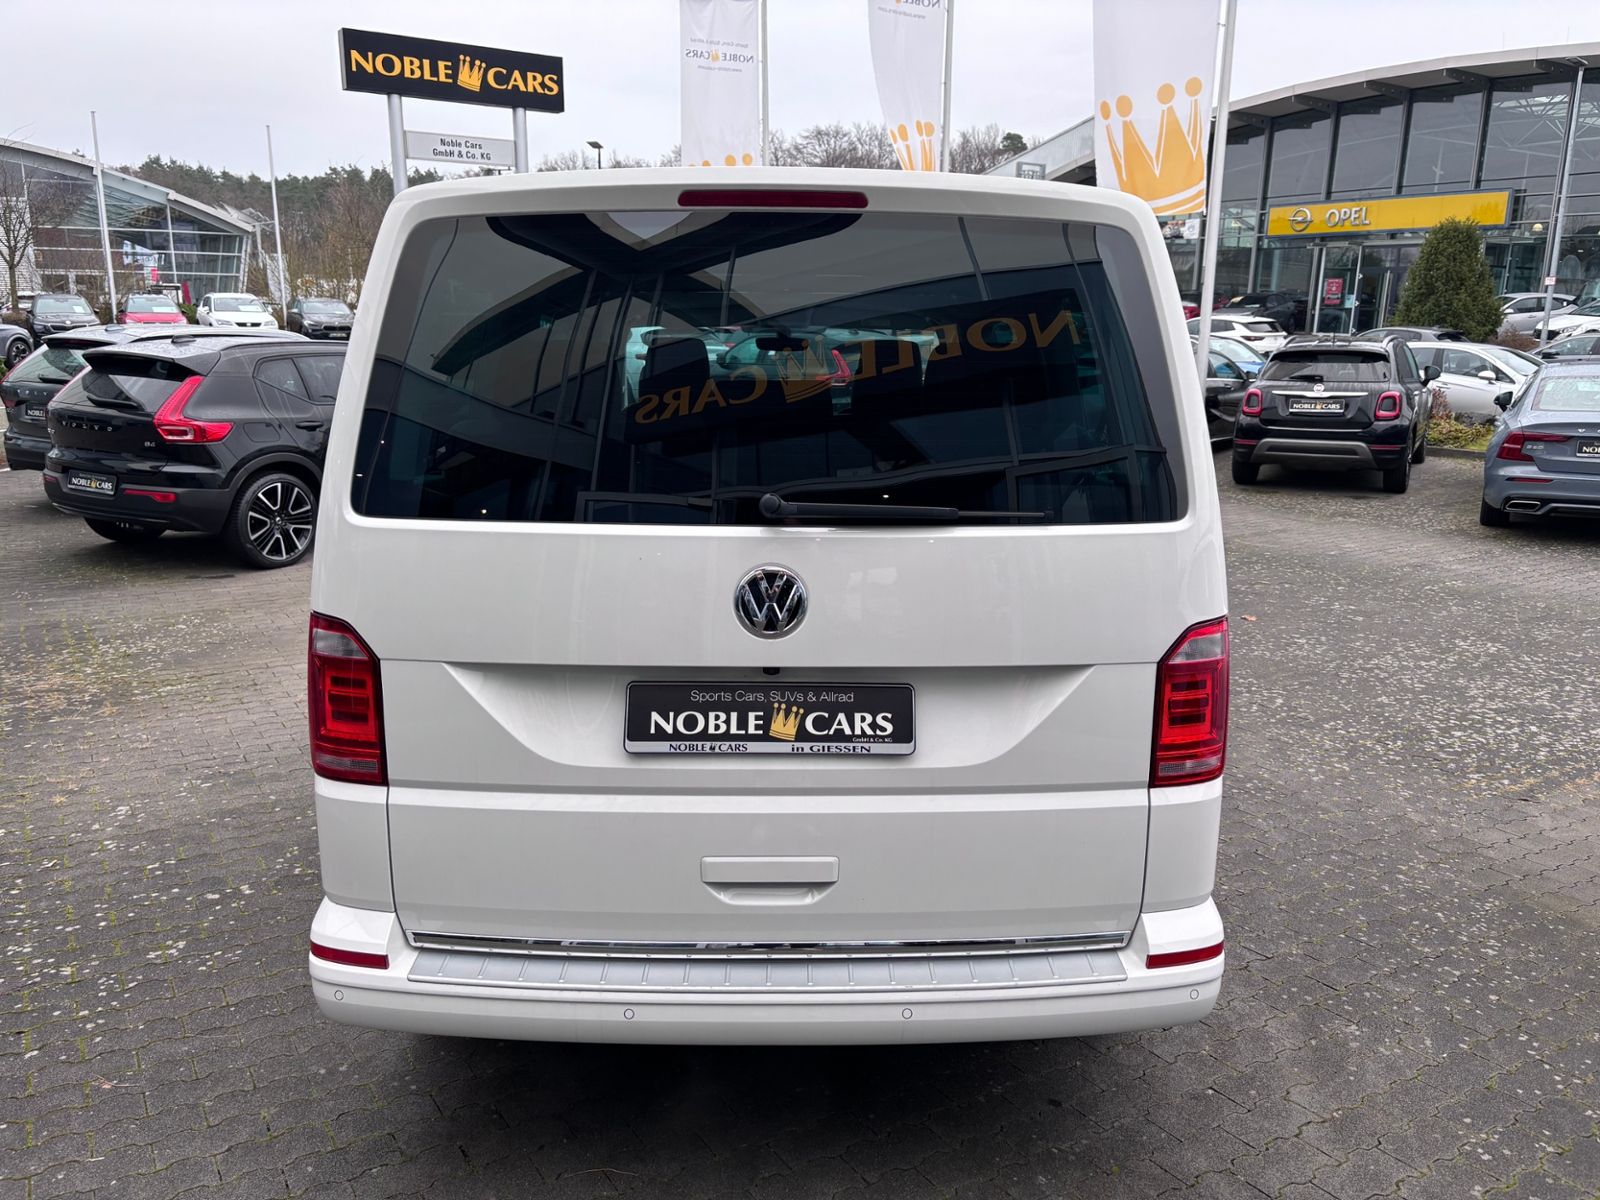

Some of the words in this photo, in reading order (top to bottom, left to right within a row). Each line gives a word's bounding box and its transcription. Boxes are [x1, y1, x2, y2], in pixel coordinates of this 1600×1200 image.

[350, 49, 453, 83] NOBLE
[487, 66, 559, 95] CARS
[440, 137, 462, 148] Noble
[464, 140, 483, 150] Cars
[432, 148, 455, 158] GmbH
[457, 150, 463, 158] &
[465, 150, 479, 160] Co.
[480, 152, 491, 161] KG
[1325, 206, 1370, 227] OPEL
[71, 477, 91, 487] NOBLE
[96, 481, 112, 489] CARS
[690, 690, 732, 703] Sports
[735, 690, 767, 703] Cars,
[770, 690, 804, 701] SUVs
[807, 691, 816, 701] &
[820, 691, 854, 702] Allrad
[650, 711, 763, 735] NOBLE
[805, 711, 894, 736] CARS
[669, 743, 707, 752] NOBLE
[718, 743, 748, 752] CARS
[791, 744, 804, 752] in
[809, 744, 871, 753] GIESSEN
